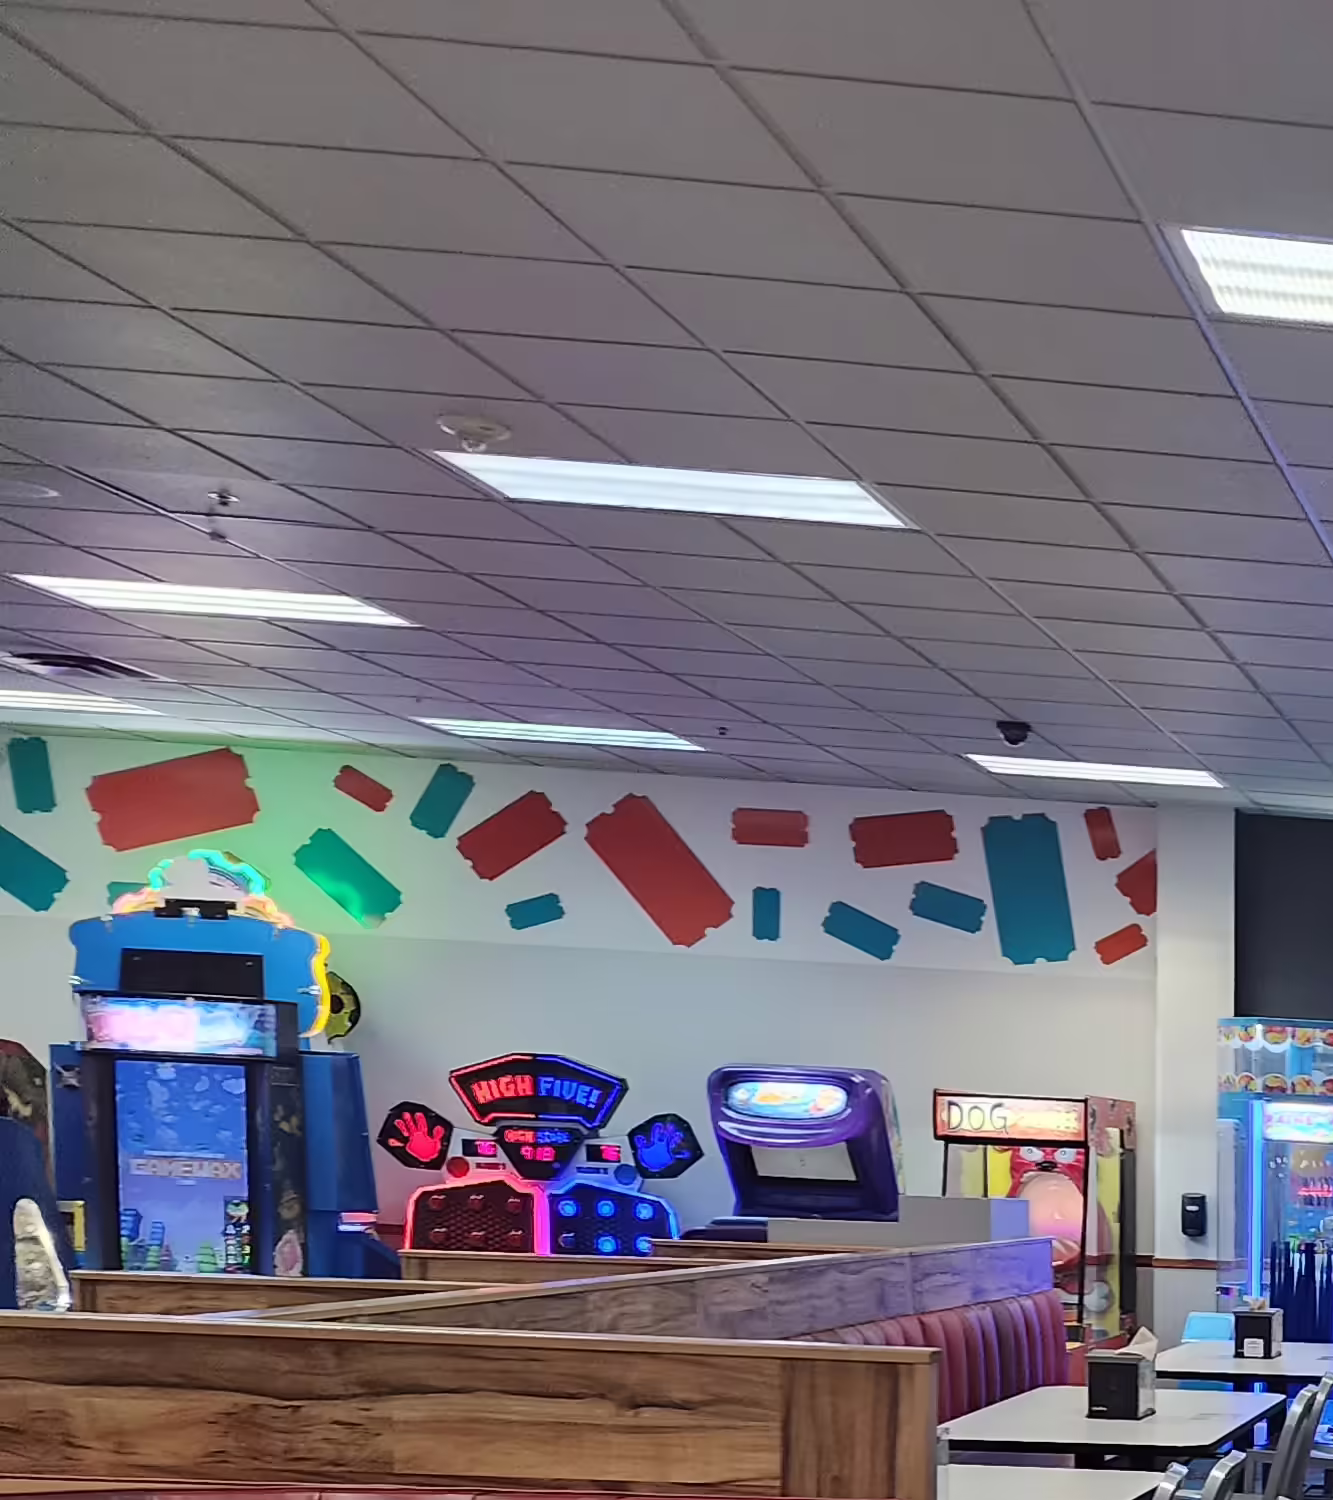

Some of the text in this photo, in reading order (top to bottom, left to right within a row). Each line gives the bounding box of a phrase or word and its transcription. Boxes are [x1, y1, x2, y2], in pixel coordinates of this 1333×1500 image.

[471, 1074, 602, 1109] HIGH FIVE!
[946, 1099, 1009, 1135] DOG
